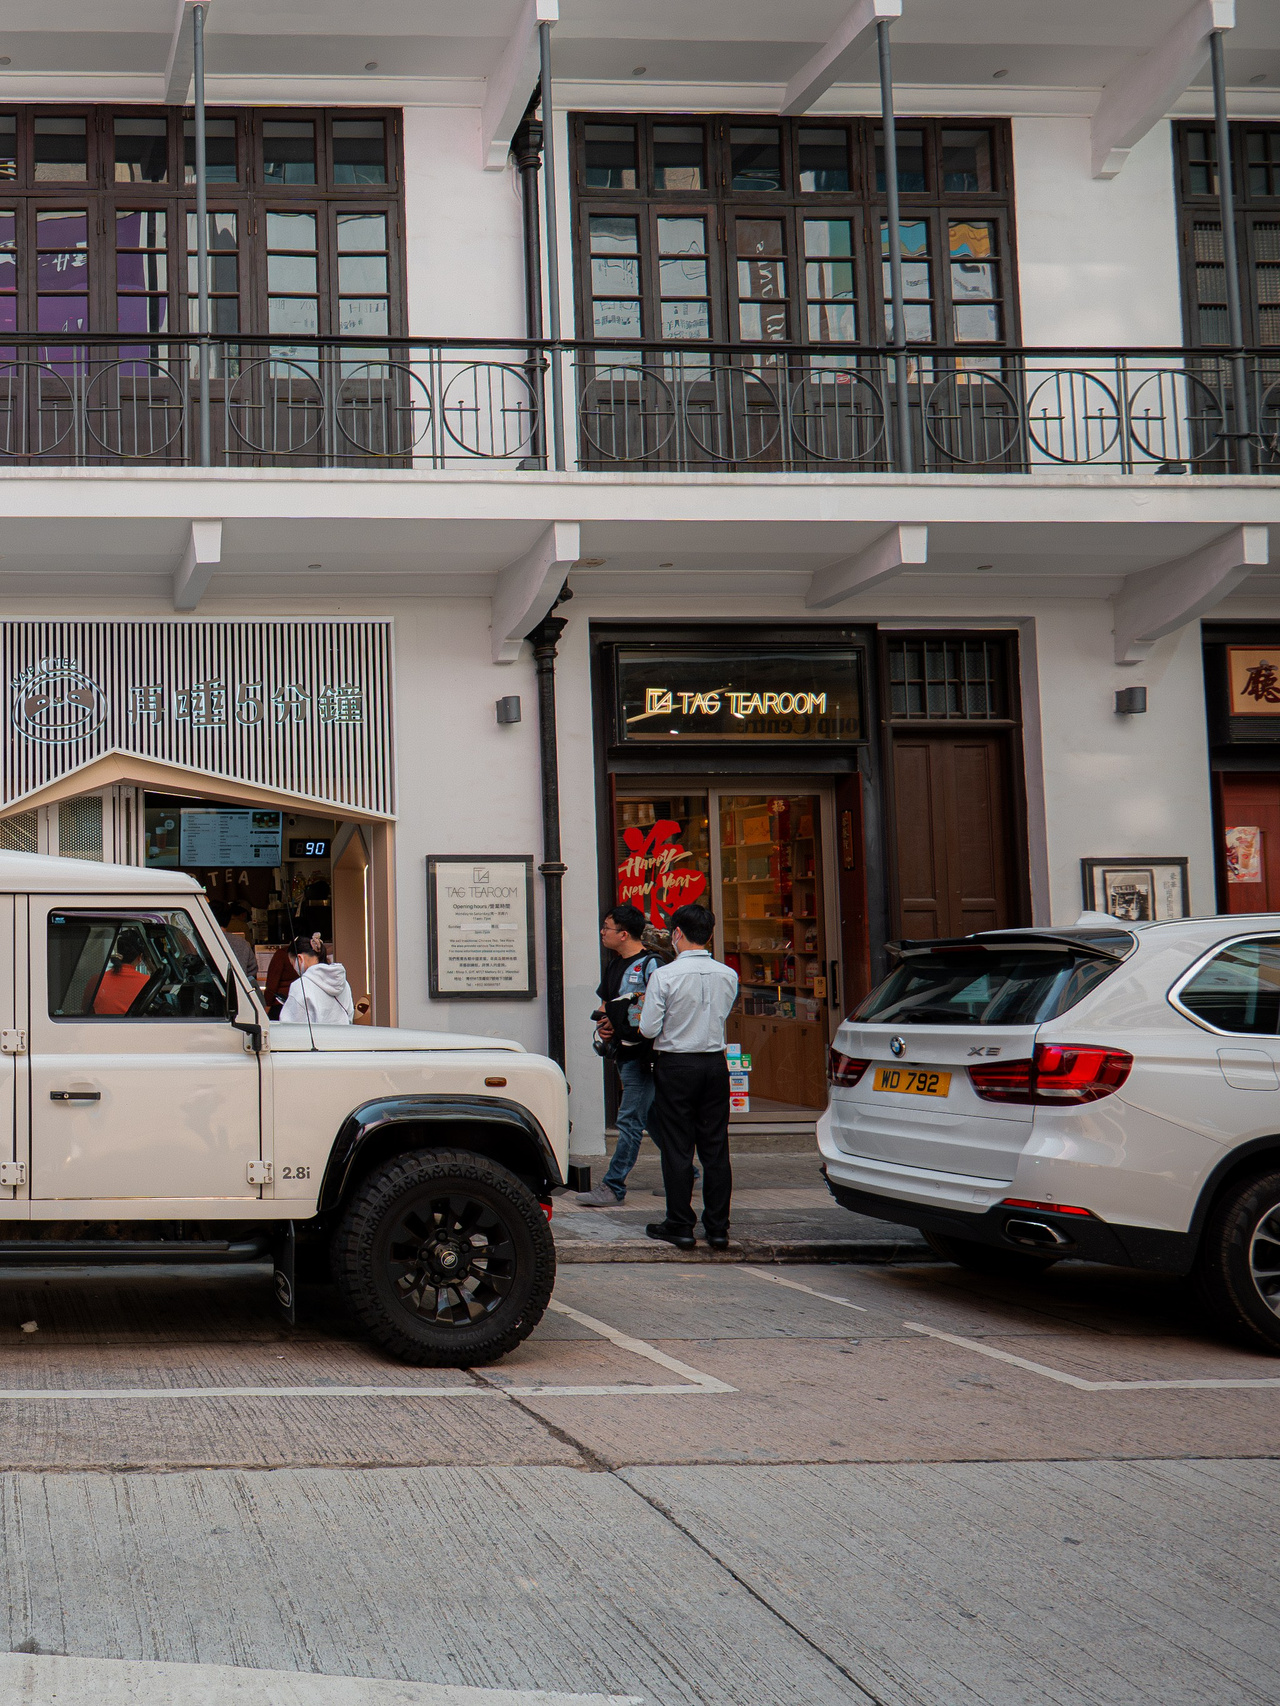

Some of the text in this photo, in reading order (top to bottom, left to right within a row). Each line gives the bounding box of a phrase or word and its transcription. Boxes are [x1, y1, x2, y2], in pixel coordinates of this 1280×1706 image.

[10, 657, 78, 689] NAP TEA
[127, 677, 365, 728] 再睡5分鐘
[677, 691, 721, 715] TAG
[724, 691, 827, 715] TEAROOM
[305, 842, 325, 855] 90
[207, 868, 250, 886] TEA
[661, 872, 702, 903] Year
[444, 886, 518, 898] TAG TEAROOM
[881, 1070, 940, 1094] WD 792
[282, 1166, 311, 1180] 2.8i
